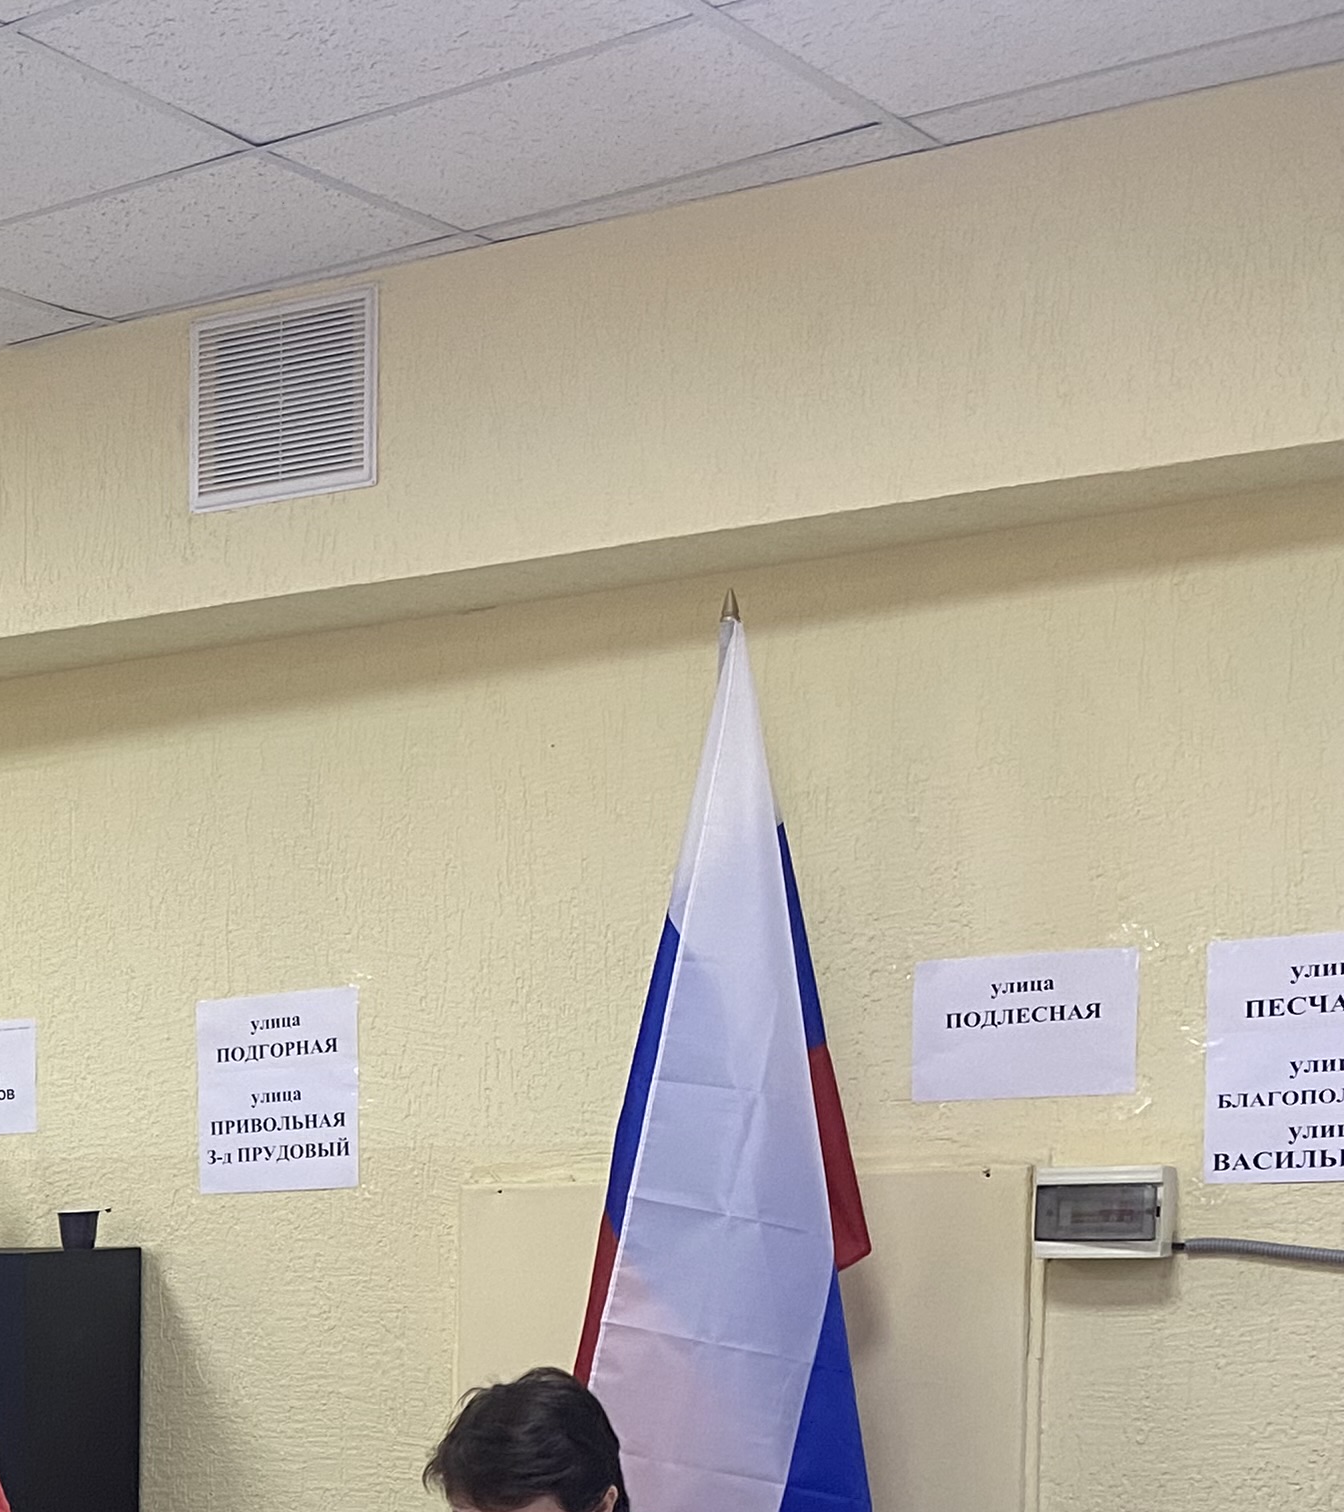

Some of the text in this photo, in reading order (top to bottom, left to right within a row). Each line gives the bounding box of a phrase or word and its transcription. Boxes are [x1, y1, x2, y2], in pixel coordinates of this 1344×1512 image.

[990, 975, 1055, 999] улица
[249, 1014, 302, 1036] улица
[945, 1001, 1103, 1031] ПОДЛЕСНАЯ
[216, 1036, 339, 1064] ПОДГОРНАЯ
[250, 1088, 303, 1109] улица
[210, 1111, 346, 1137] ПРИВОЛЬНАЯ
[206, 1137, 351, 1166] 3-д ПРУДОВЫЙ
[1213, 1148, 1344, 1173] ВАСИЛЬ
